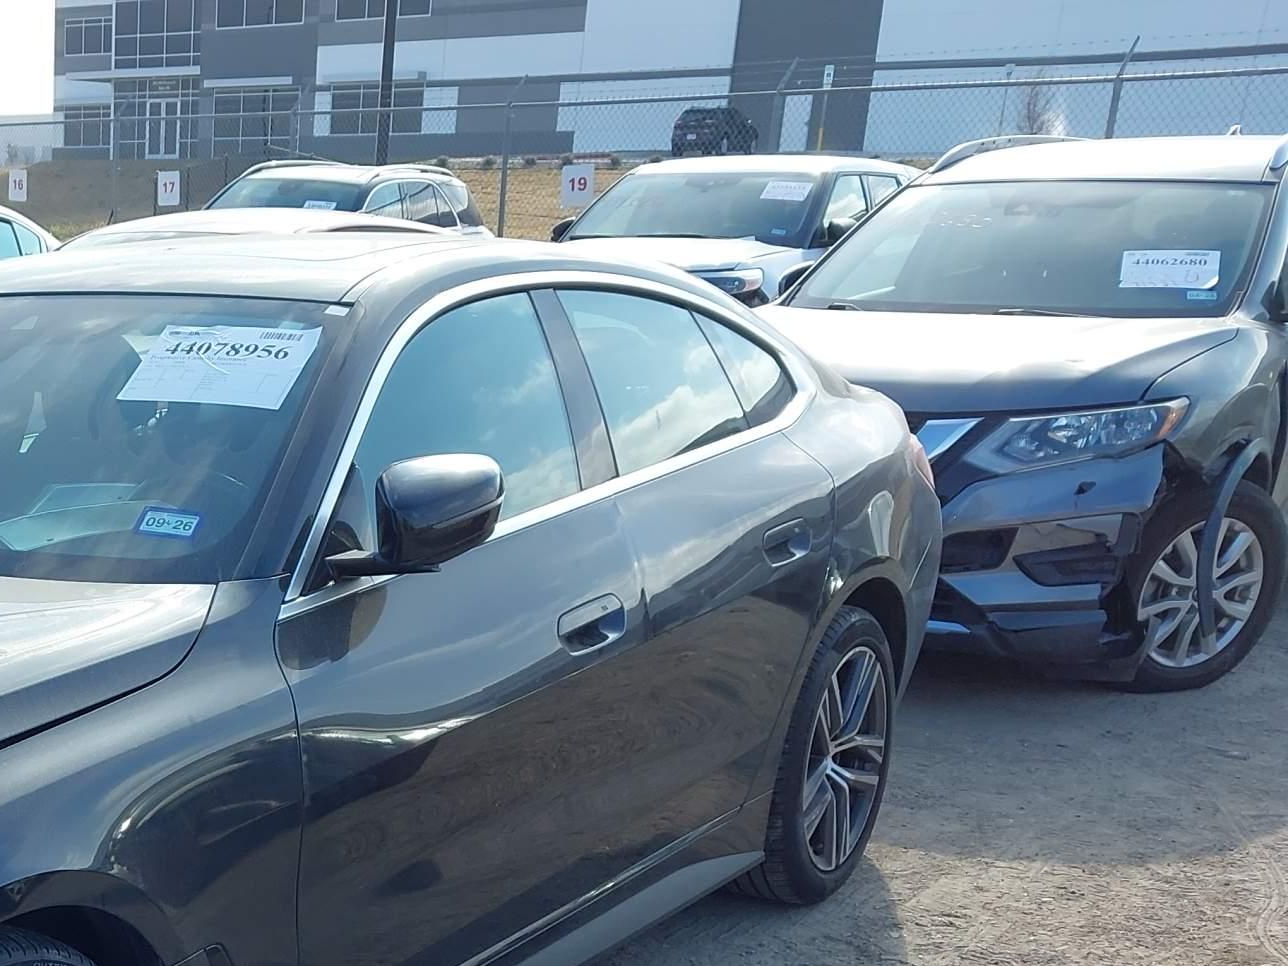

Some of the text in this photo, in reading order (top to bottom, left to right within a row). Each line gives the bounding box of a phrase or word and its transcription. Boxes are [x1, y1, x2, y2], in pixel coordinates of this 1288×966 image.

[12, 179, 24, 191] 16
[162, 182, 175, 193] 17
[569, 176, 587, 192] 19
[1132, 257, 1208, 267] 44062680
[165, 341, 292, 360] 44078956
